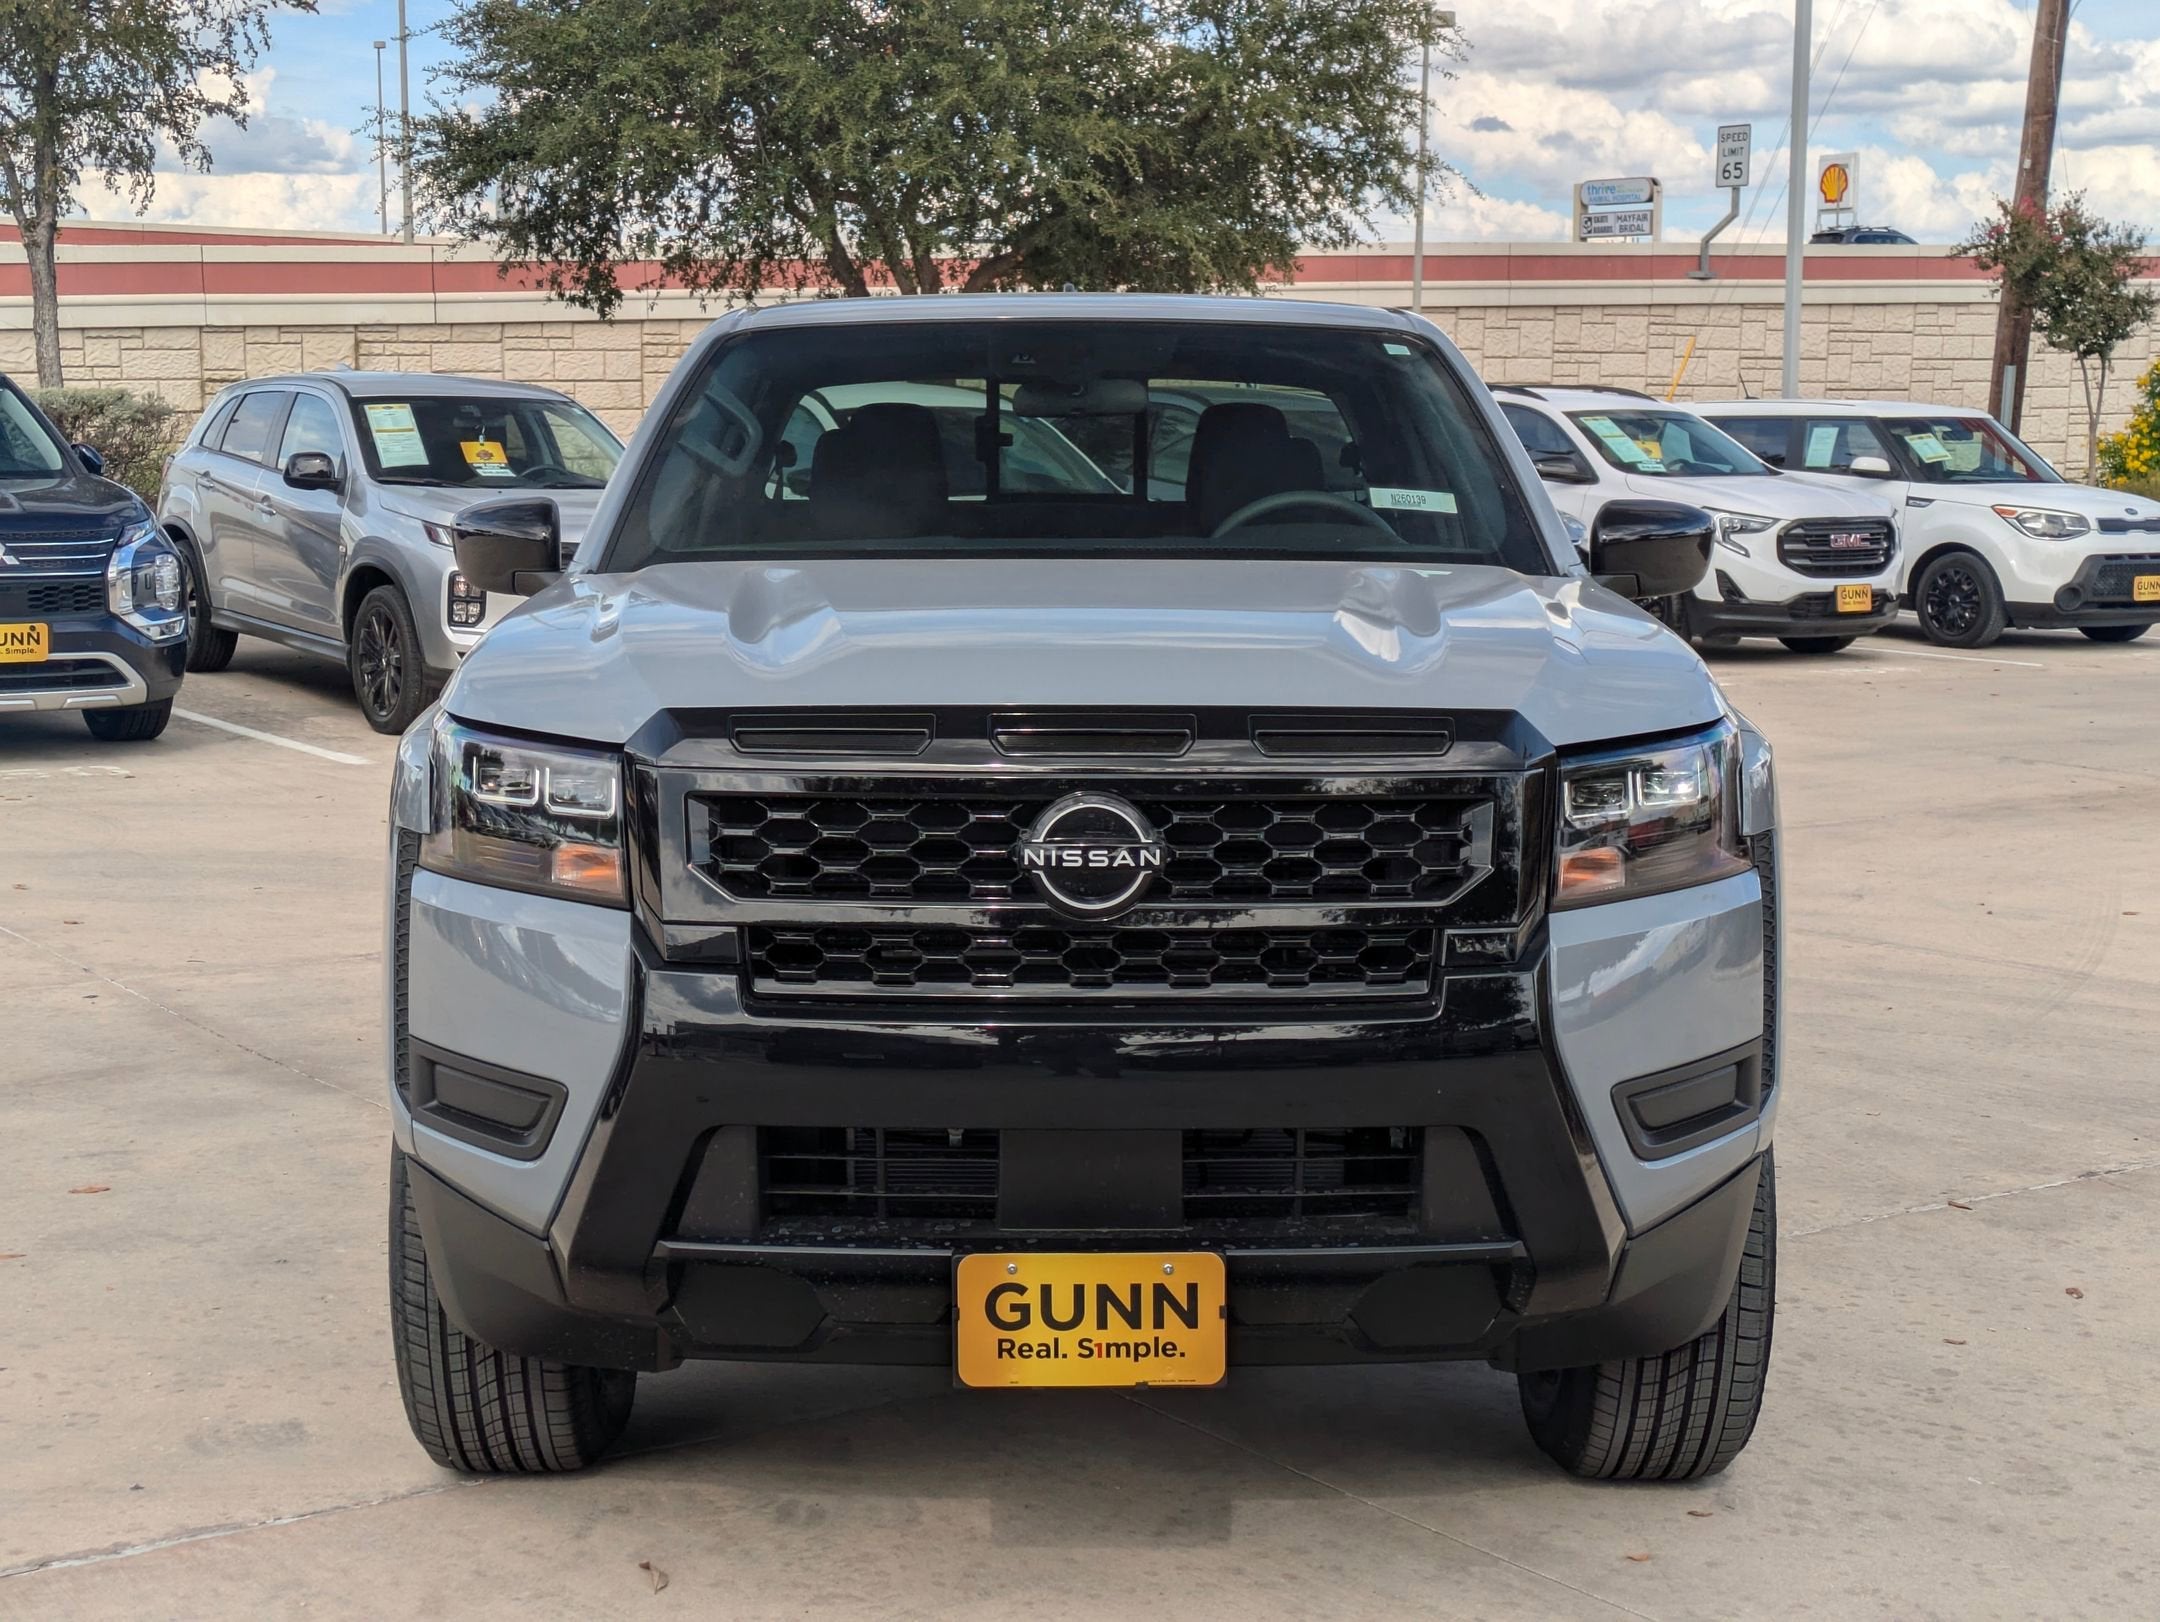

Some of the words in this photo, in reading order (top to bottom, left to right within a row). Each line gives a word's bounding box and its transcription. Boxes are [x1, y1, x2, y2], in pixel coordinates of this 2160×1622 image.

[1721, 132, 1748, 143] SPEED
[1722, 146, 1745, 157] LIMIT
[1722, 162, 1743, 180] 65
[1617, 213, 1648, 224] MAYFAIR
[1619, 223, 1645, 233] BRIDAL
[1830, 533, 1871, 549] GMC
[1841, 588, 1868, 600] GUNN
[0, 631, 40, 646] UNN
[1024, 849, 1160, 867] NISSAN
[984, 1282, 1199, 1331] GUNN
[997, 1337, 1068, 1359] Real.
